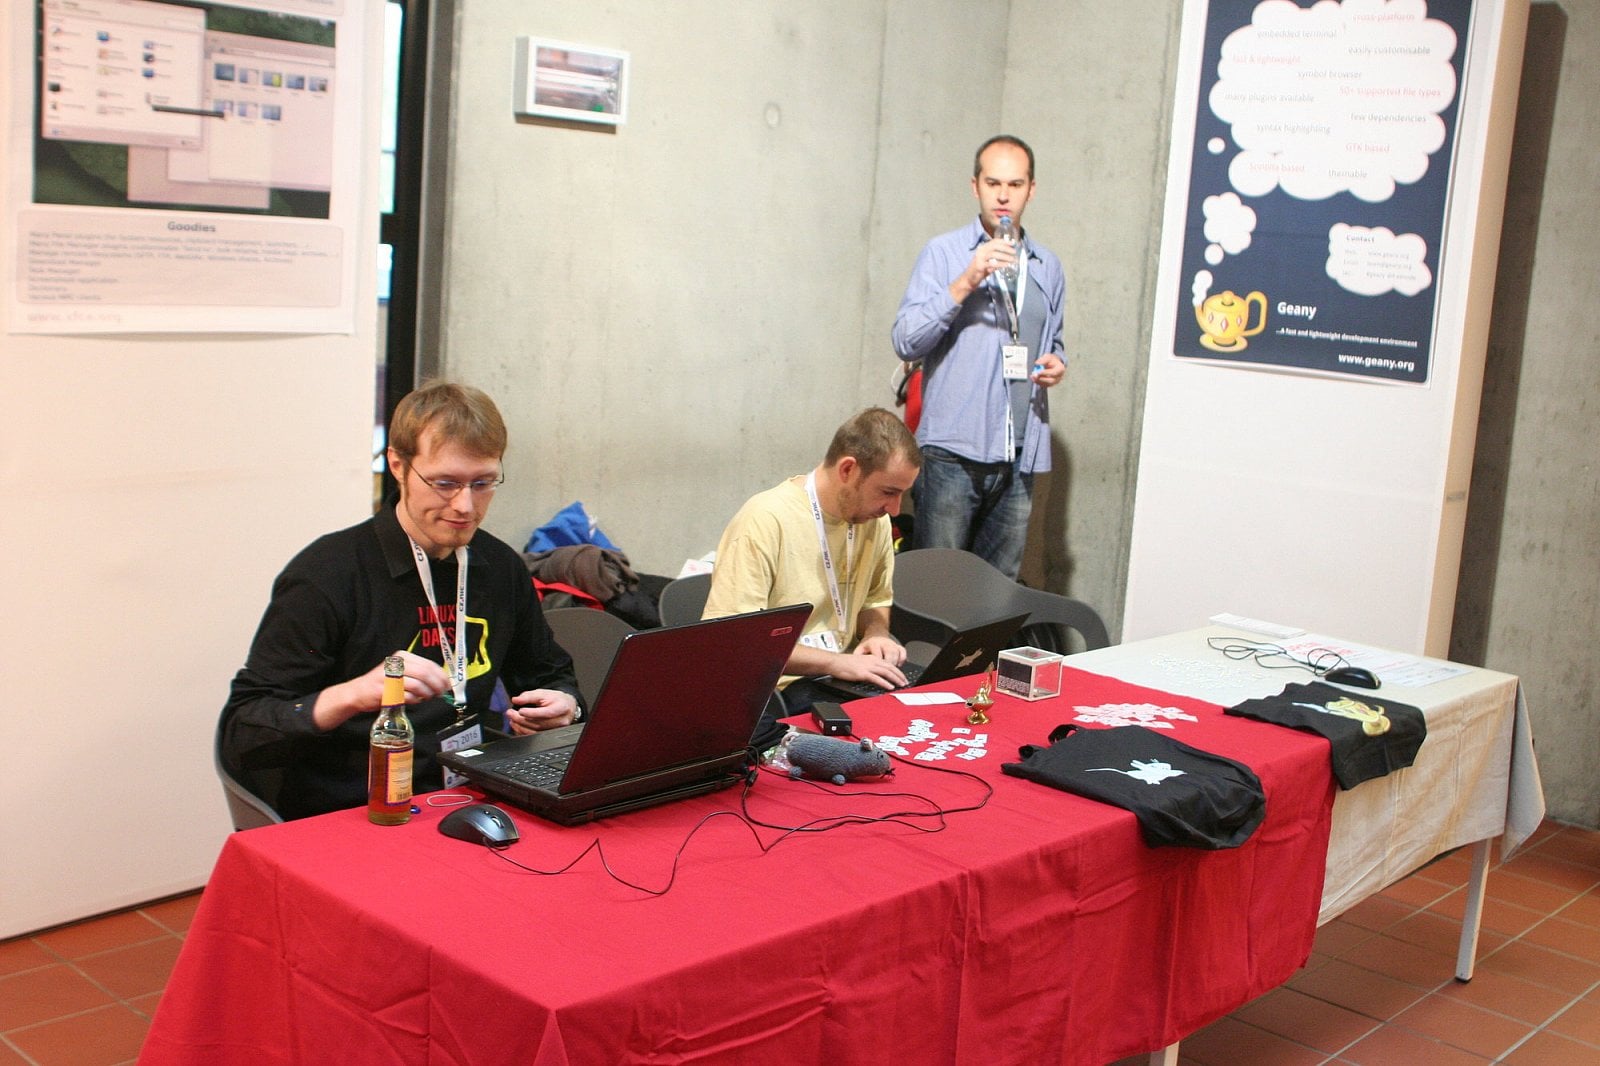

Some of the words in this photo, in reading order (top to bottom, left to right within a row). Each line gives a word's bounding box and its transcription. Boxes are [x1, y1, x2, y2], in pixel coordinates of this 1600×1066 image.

[1257, 29, 1300, 39] embedded
[1302, 30, 1337, 39] terminal
[1348, 46, 1371, 56] easily
[1373, 46, 1431, 55] customisable
[1257, 55, 1301, 65] lightweight
[1297, 70, 1327, 80] symbol
[1329, 70, 1362, 80] browser
[1357, 87, 1401, 98] supported
[1402, 87, 1416, 97] file
[1417, 88, 1441, 98] types
[1248, 93, 1278, 104] plugins
[1279, 93, 1315, 103] available
[1350, 113, 1366, 122] few
[1368, 113, 1427, 124] dependencies
[1256, 124, 1282, 135] syntax
[1283, 125, 1331, 136] highlighting
[1364, 144, 1390, 153] based
[1281, 163, 1305, 173] based
[167, 221, 216, 233] Goodies
[1345, 234, 1375, 244] Contact
[1277, 301, 1317, 320] Geany
[1286, 327, 1297, 337] fast
[1297, 328, 1309, 338] and
[1309, 329, 1341, 342] lightweight
[1341, 332, 1379, 344] development
[1379, 337, 1418, 349] environment
[1338, 353, 1415, 372] www.geany.org
